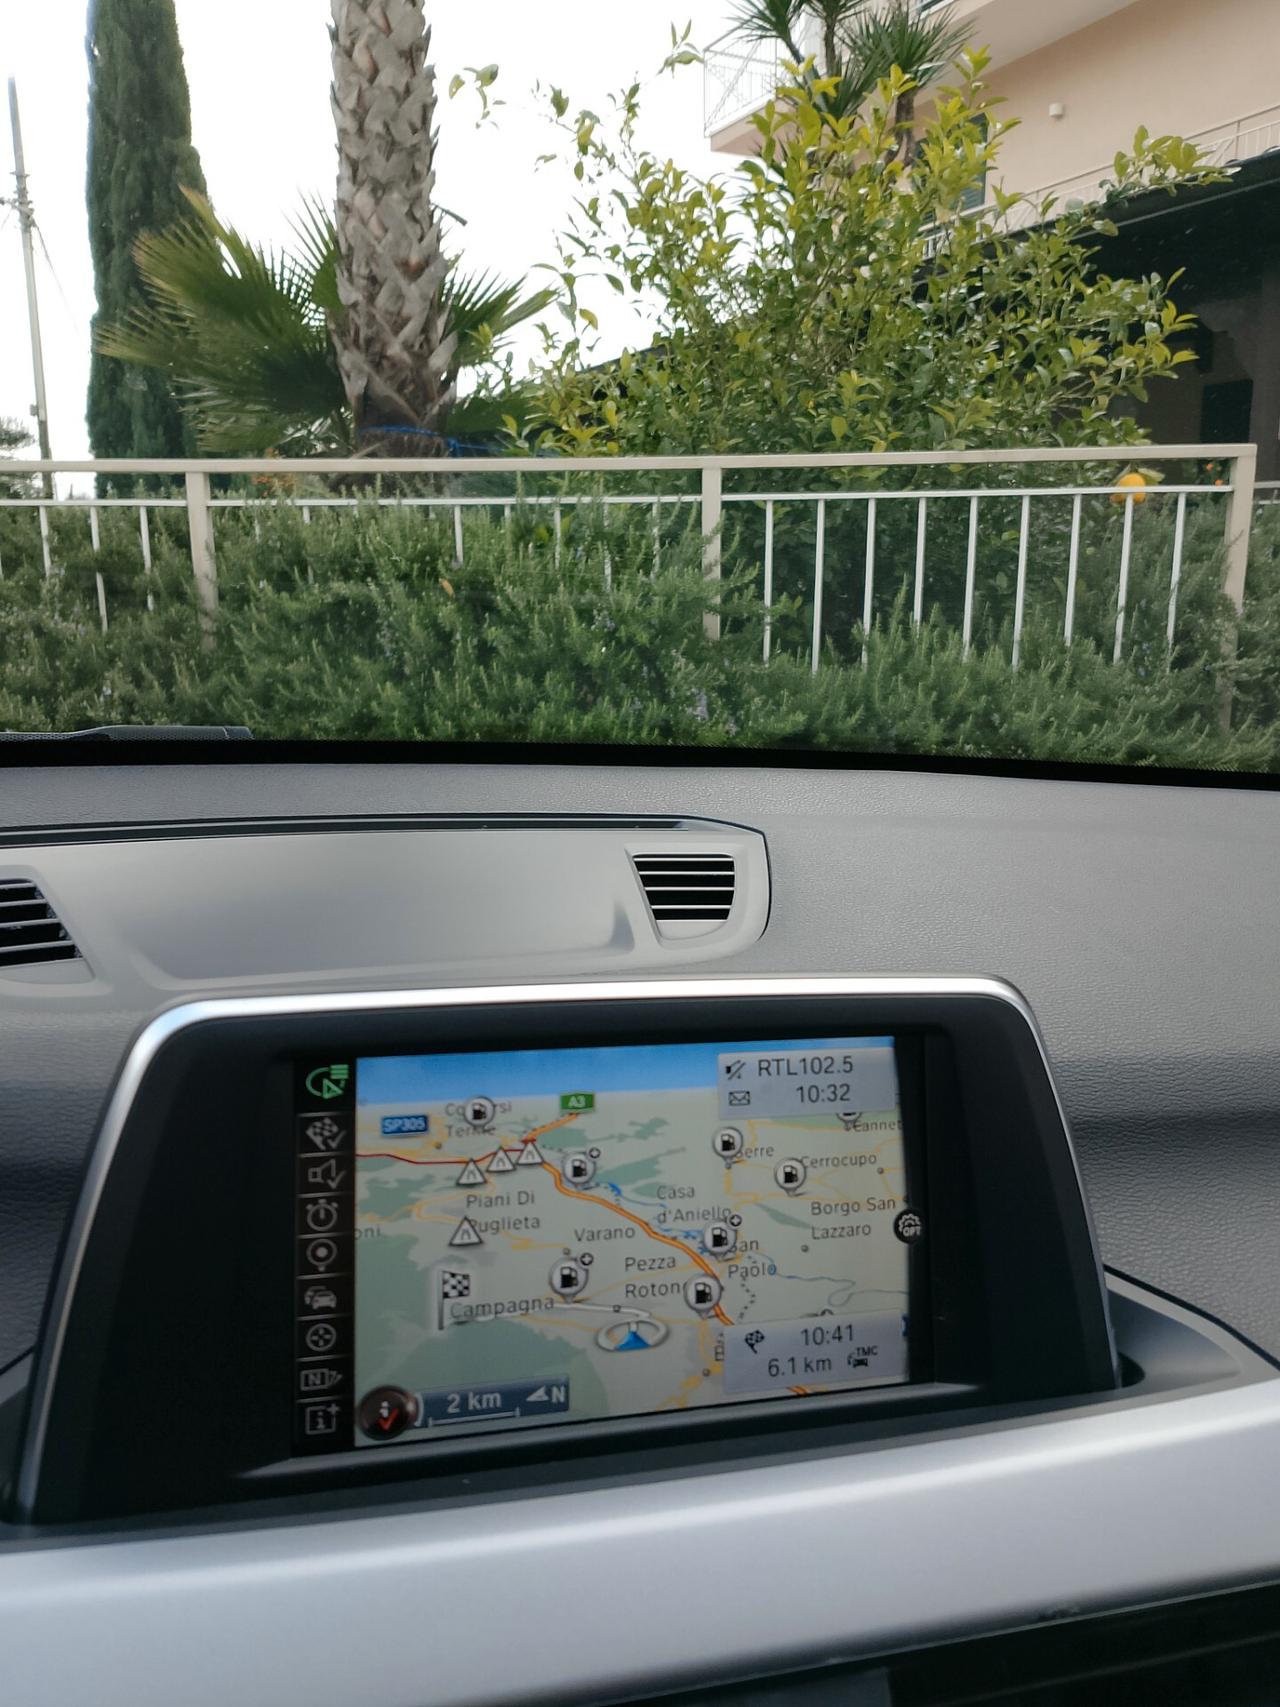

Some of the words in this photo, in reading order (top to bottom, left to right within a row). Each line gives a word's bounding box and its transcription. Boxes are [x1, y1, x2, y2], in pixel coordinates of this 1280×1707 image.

[757, 1055, 854, 1077] RTL102.5
[568, 1095, 586, 1108] A3
[796, 1083, 851, 1104] 10:32
[383, 1117, 426, 1133] SP305
[800, 1153, 878, 1170] Cerrocupo
[465, 1192, 510, 1209] Piani
[517, 1190, 536, 1206] Di
[656, 1185, 696, 1200] Casa
[656, 1206, 732, 1225] d'Aniello
[810, 1200, 861, 1217] Borgo
[866, 1197, 897, 1212] San
[574, 1227, 636, 1243] Varano
[810, 1224, 872, 1241] Lazzaro
[903, 1226, 921, 1237] OPT
[624, 1256, 677, 1272] Pezza
[727, 1262, 777, 1279] Paolo
[625, 1281, 687, 1298] Roton
[449, 1296, 555, 1319] Campagna
[800, 1324, 855, 1346] 10:41
[856, 1345, 879, 1356] TMC
[768, 1356, 797, 1377] 6.1
[804, 1355, 833, 1373] km
[446, 1395, 460, 1413] 2
[467, 1391, 502, 1410] km
[551, 1385, 567, 1403] N
